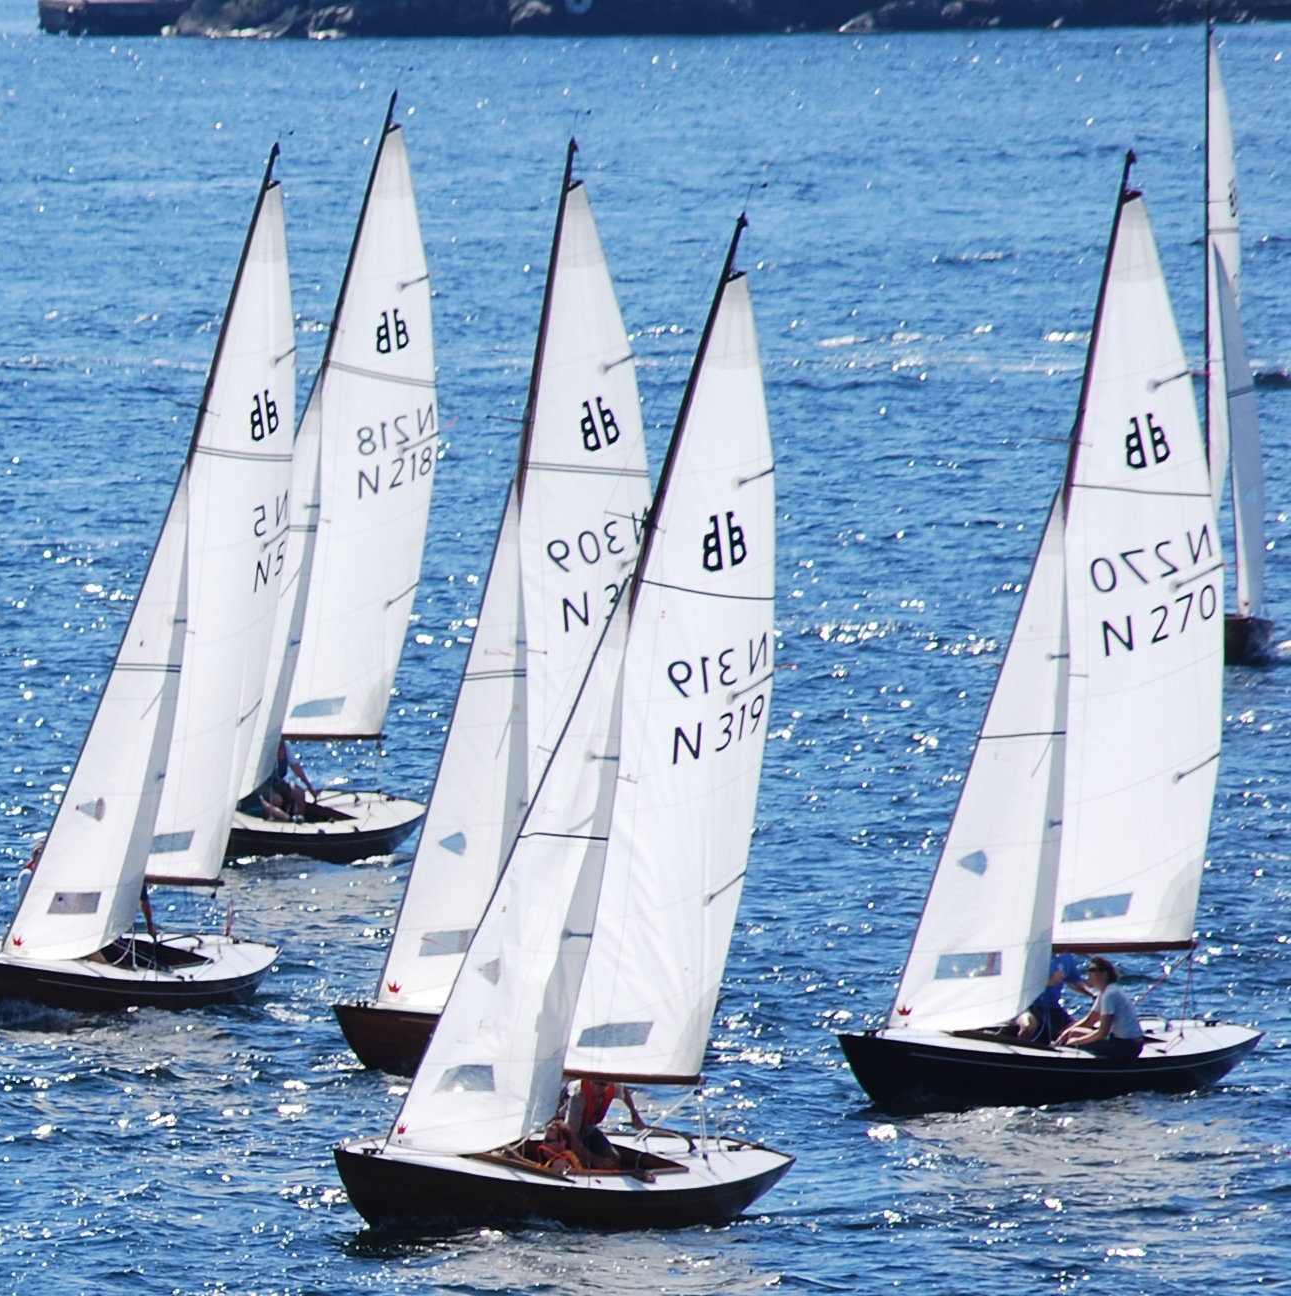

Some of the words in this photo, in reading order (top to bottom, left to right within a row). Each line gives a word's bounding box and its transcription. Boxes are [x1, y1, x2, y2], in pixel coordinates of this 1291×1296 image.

[358, 465, 380, 500] N
[389, 446, 433, 490] 218
[254, 553, 271, 593] N
[562, 591, 590, 633] N
[1101, 617, 1134, 657] N
[1149, 584, 1216, 648] 270
[672, 721, 703, 765] N
[715, 693, 765, 752] 319
